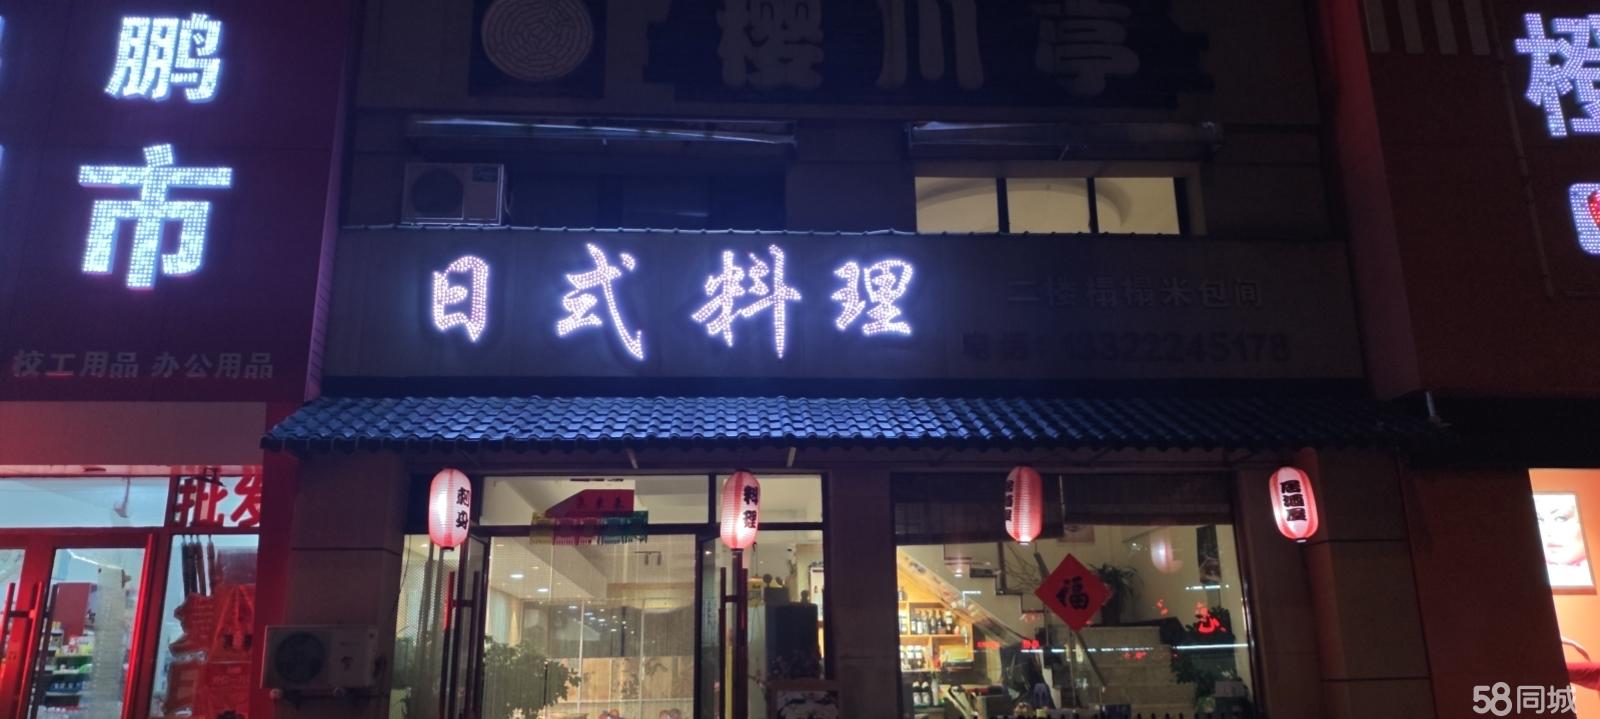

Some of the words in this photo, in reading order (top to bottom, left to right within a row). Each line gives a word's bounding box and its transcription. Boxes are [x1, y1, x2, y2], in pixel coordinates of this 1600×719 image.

[104, 12, 223, 102] 鹏
[77, 143, 234, 290] 市
[432, 243, 914, 360] 日式料理
[150, 350, 275, 379] 办公用品
[1280, 480, 1307, 521] 居酒屋
[1056, 576, 1090, 610] 福
